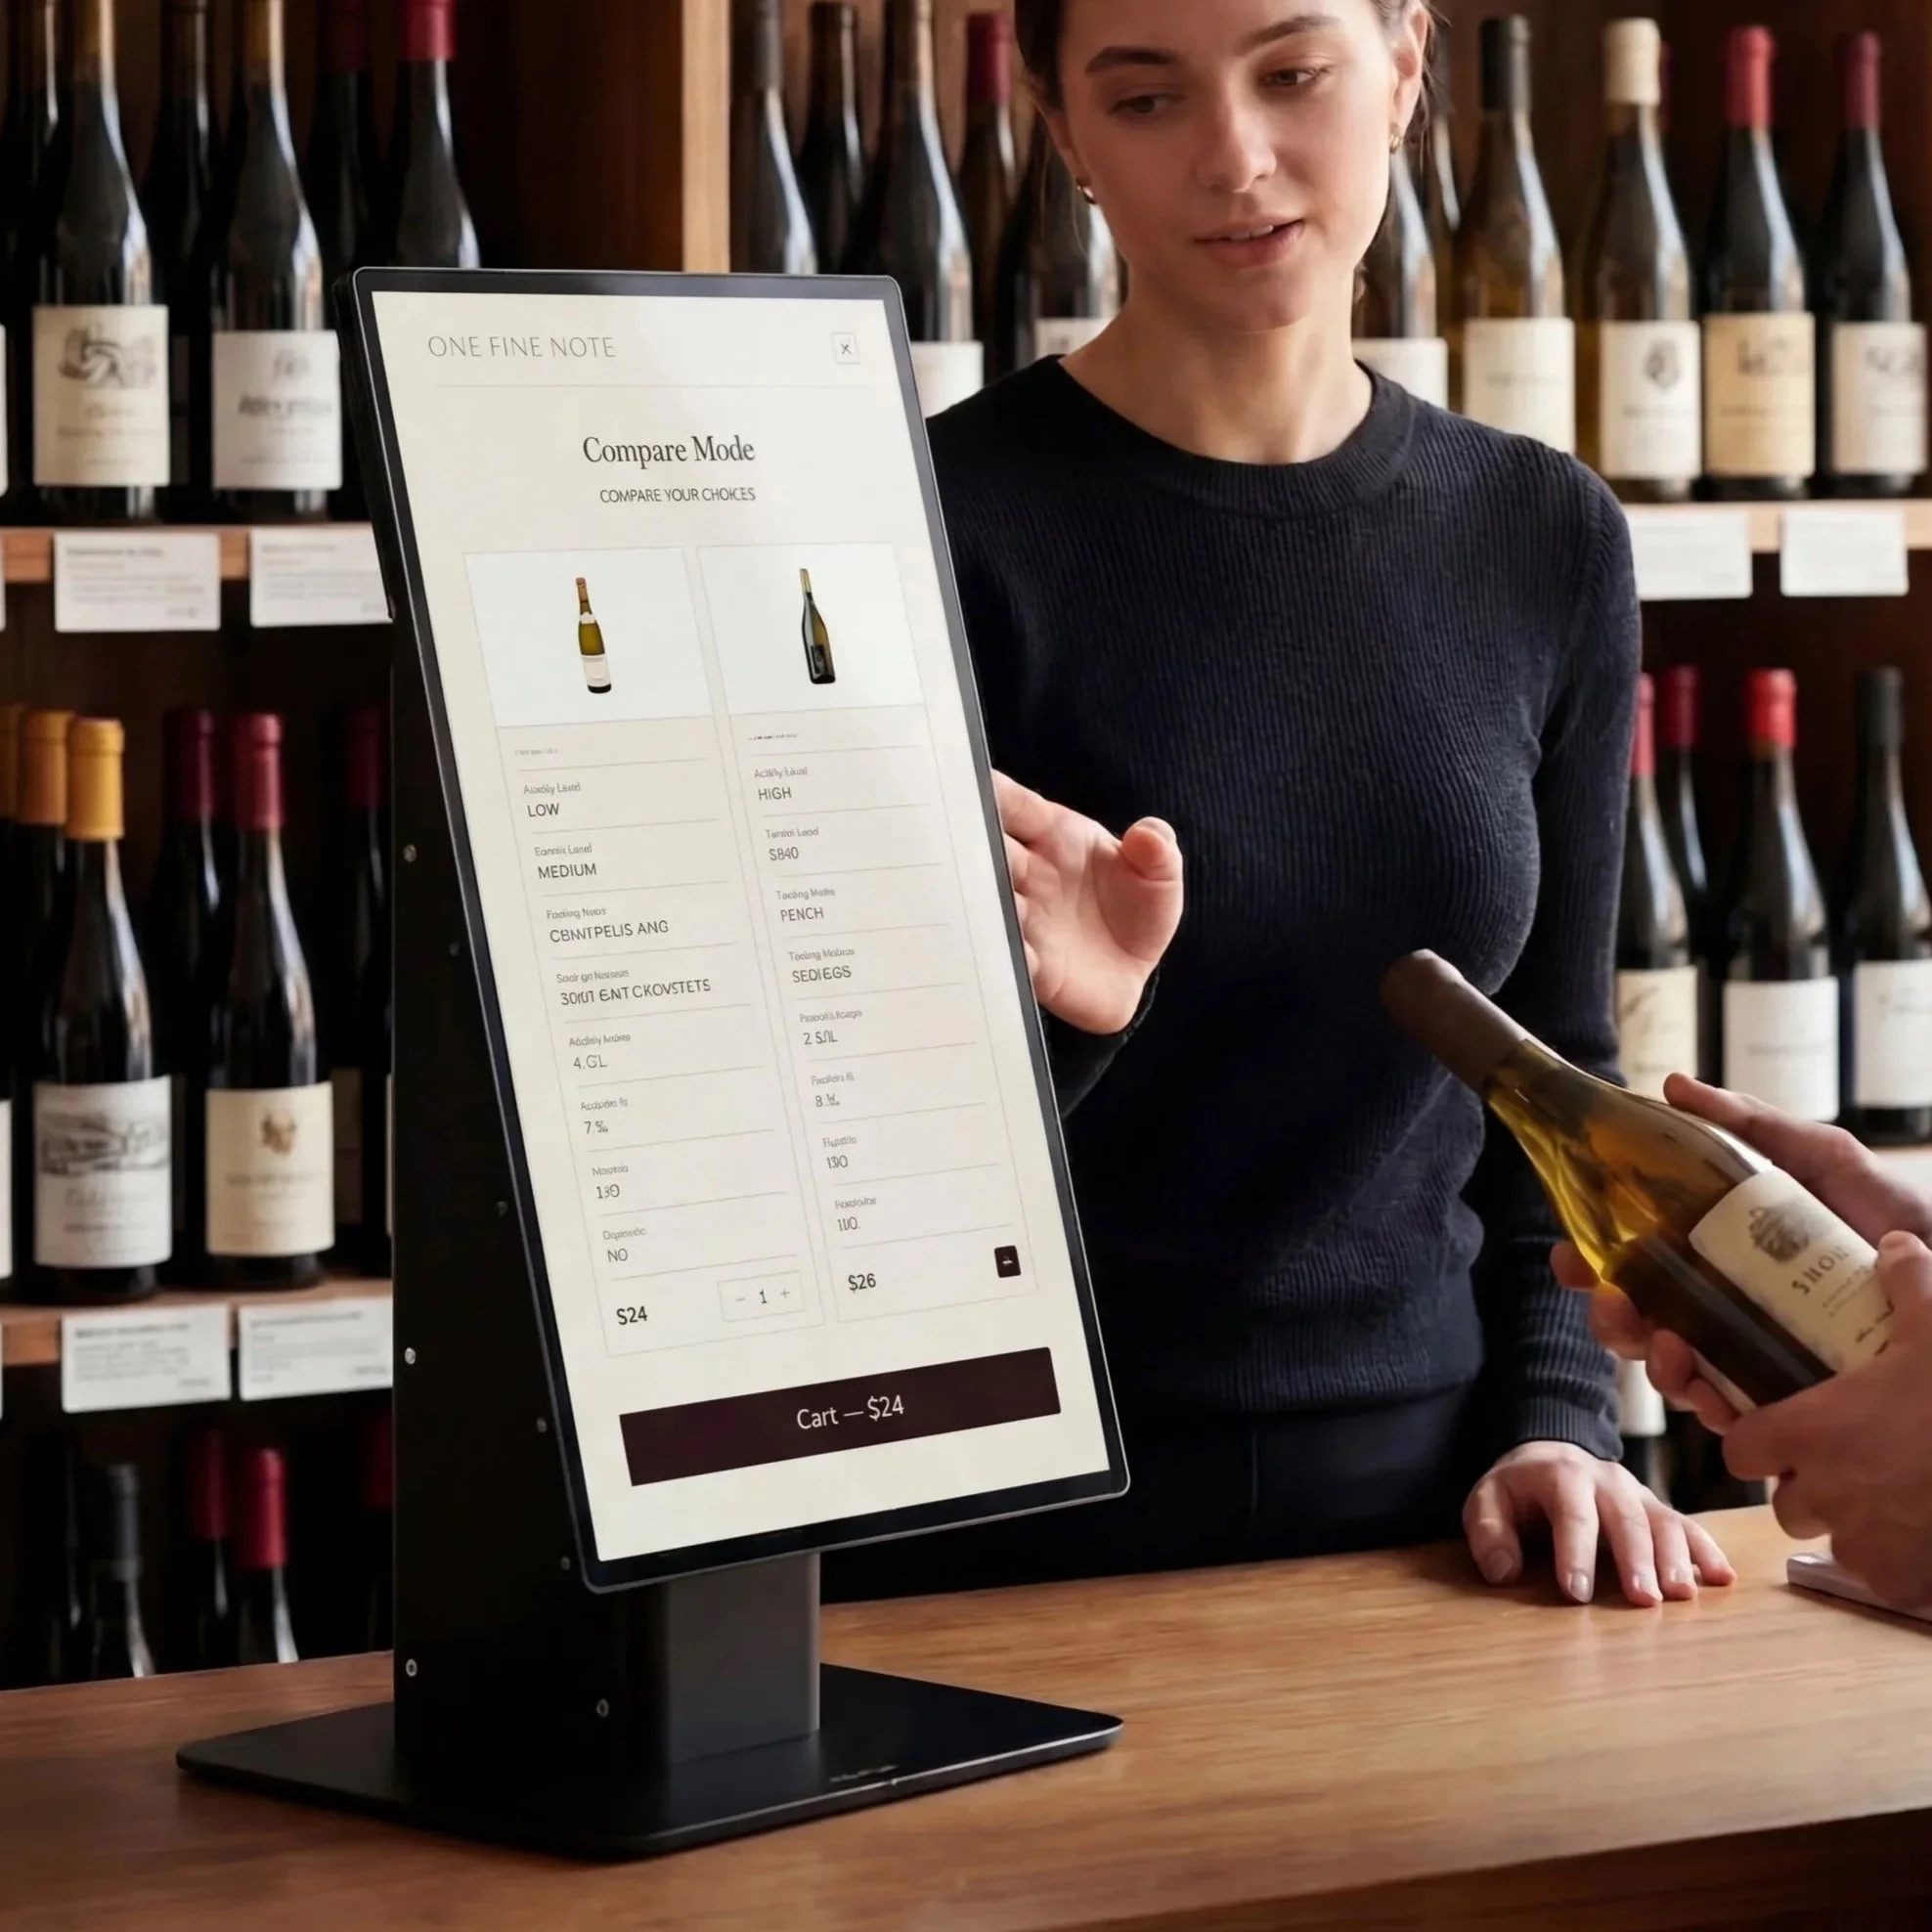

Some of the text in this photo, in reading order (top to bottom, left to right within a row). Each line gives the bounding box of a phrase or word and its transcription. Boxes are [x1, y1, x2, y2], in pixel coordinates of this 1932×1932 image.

[428, 335, 616, 358] ONE FINE NOTE
[582, 434, 756, 470] Compare Mode
[599, 489, 662, 504] COMPARE
[664, 488, 700, 502] YOUR
[758, 787, 792, 802] HIGH
[527, 803, 560, 818] LOW
[538, 862, 597, 880] MEDIUM
[779, 906, 824, 923] PENCH
[607, 1249, 629, 1263] NO
[848, 1273, 877, 1294] $26
[796, 1407, 839, 1430] Cart
